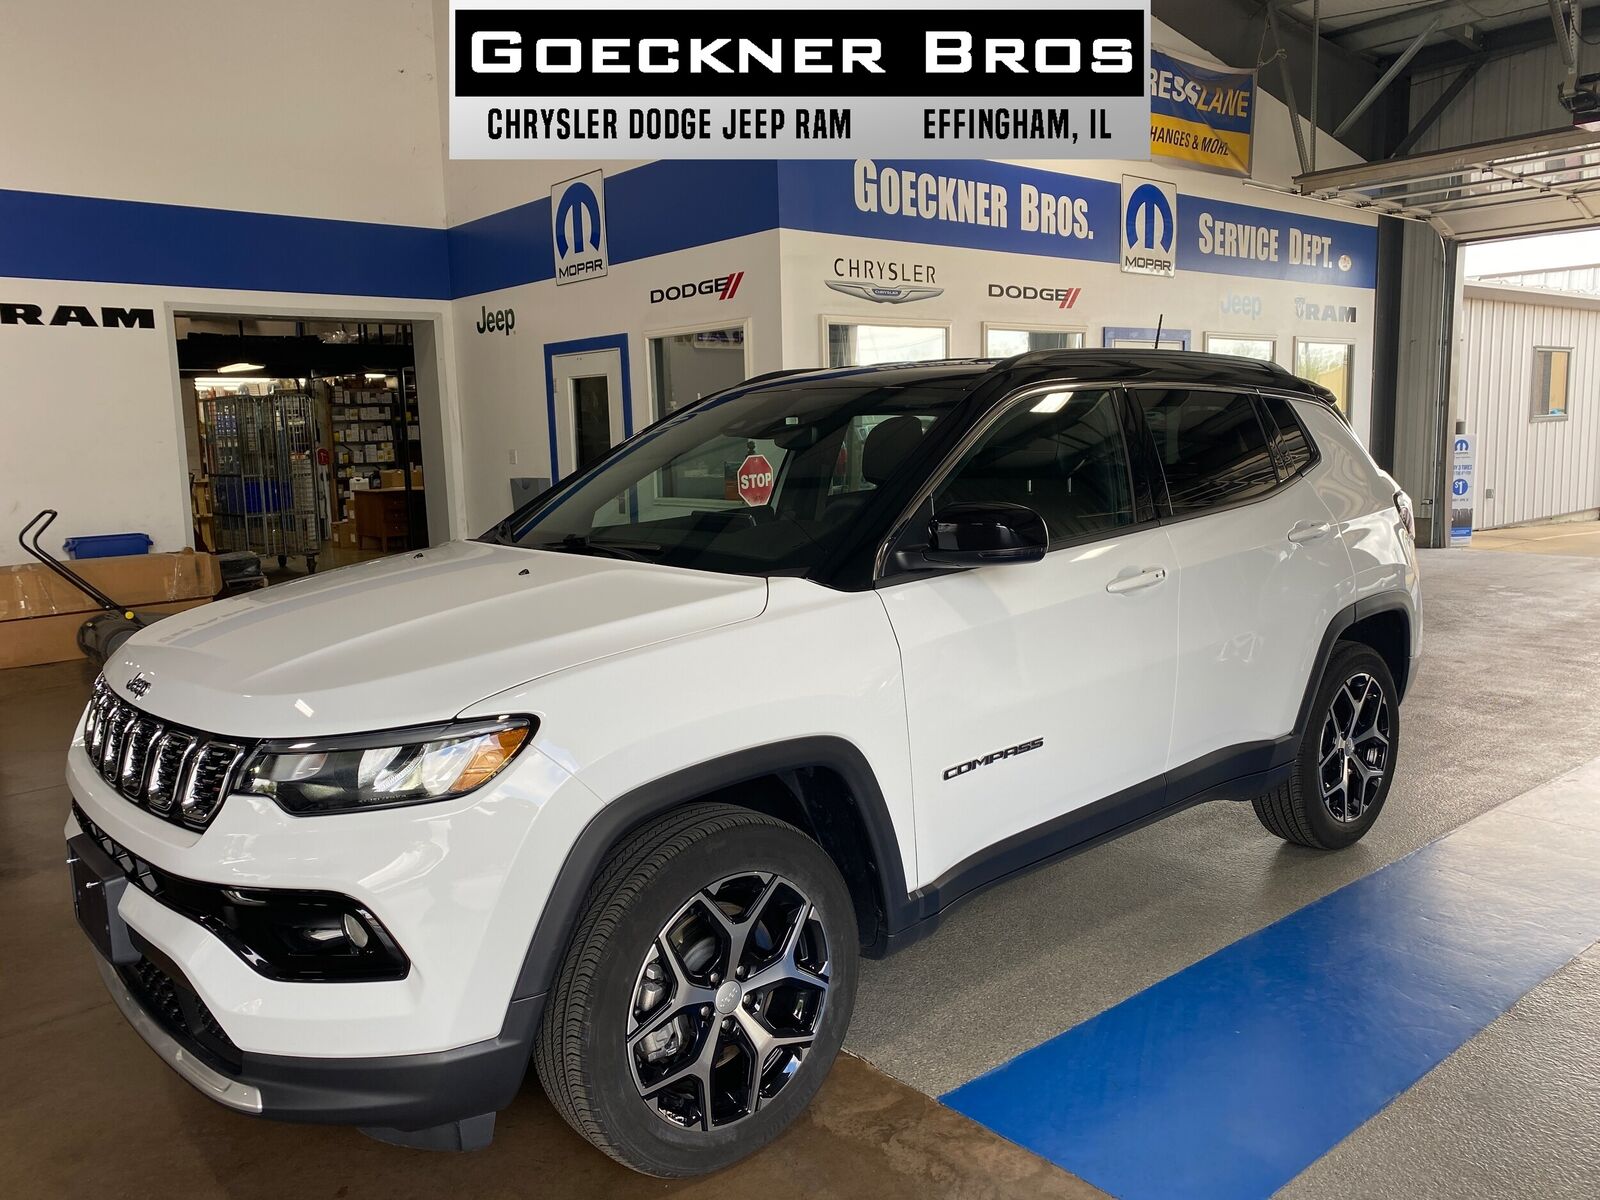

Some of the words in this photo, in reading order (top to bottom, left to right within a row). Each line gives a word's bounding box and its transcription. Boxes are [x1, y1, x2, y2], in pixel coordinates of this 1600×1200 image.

[1191, 134, 1199, 150] &
[853, 158, 1008, 229] GOECKNER
[1020, 183, 1094, 240] BROS.
[1198, 212, 1279, 262] SERVICE
[1289, 227, 1333, 269] DEPT.
[558, 258, 603, 279] MOPAR
[834, 257, 936, 284] CHRYSLER
[1125, 255, 1172, 272] MOPAR
[650, 276, 730, 304] DODGE
[988, 283, 1069, 302] DODGE
[0, 302, 155, 329] RAM
[1220, 290, 1262, 320] Jeep
[1305, 303, 1357, 322] RAM
[476, 305, 516, 336] Jeep
[740, 472, 771, 490] STOP
[943, 737, 1044, 781] COMPASS
